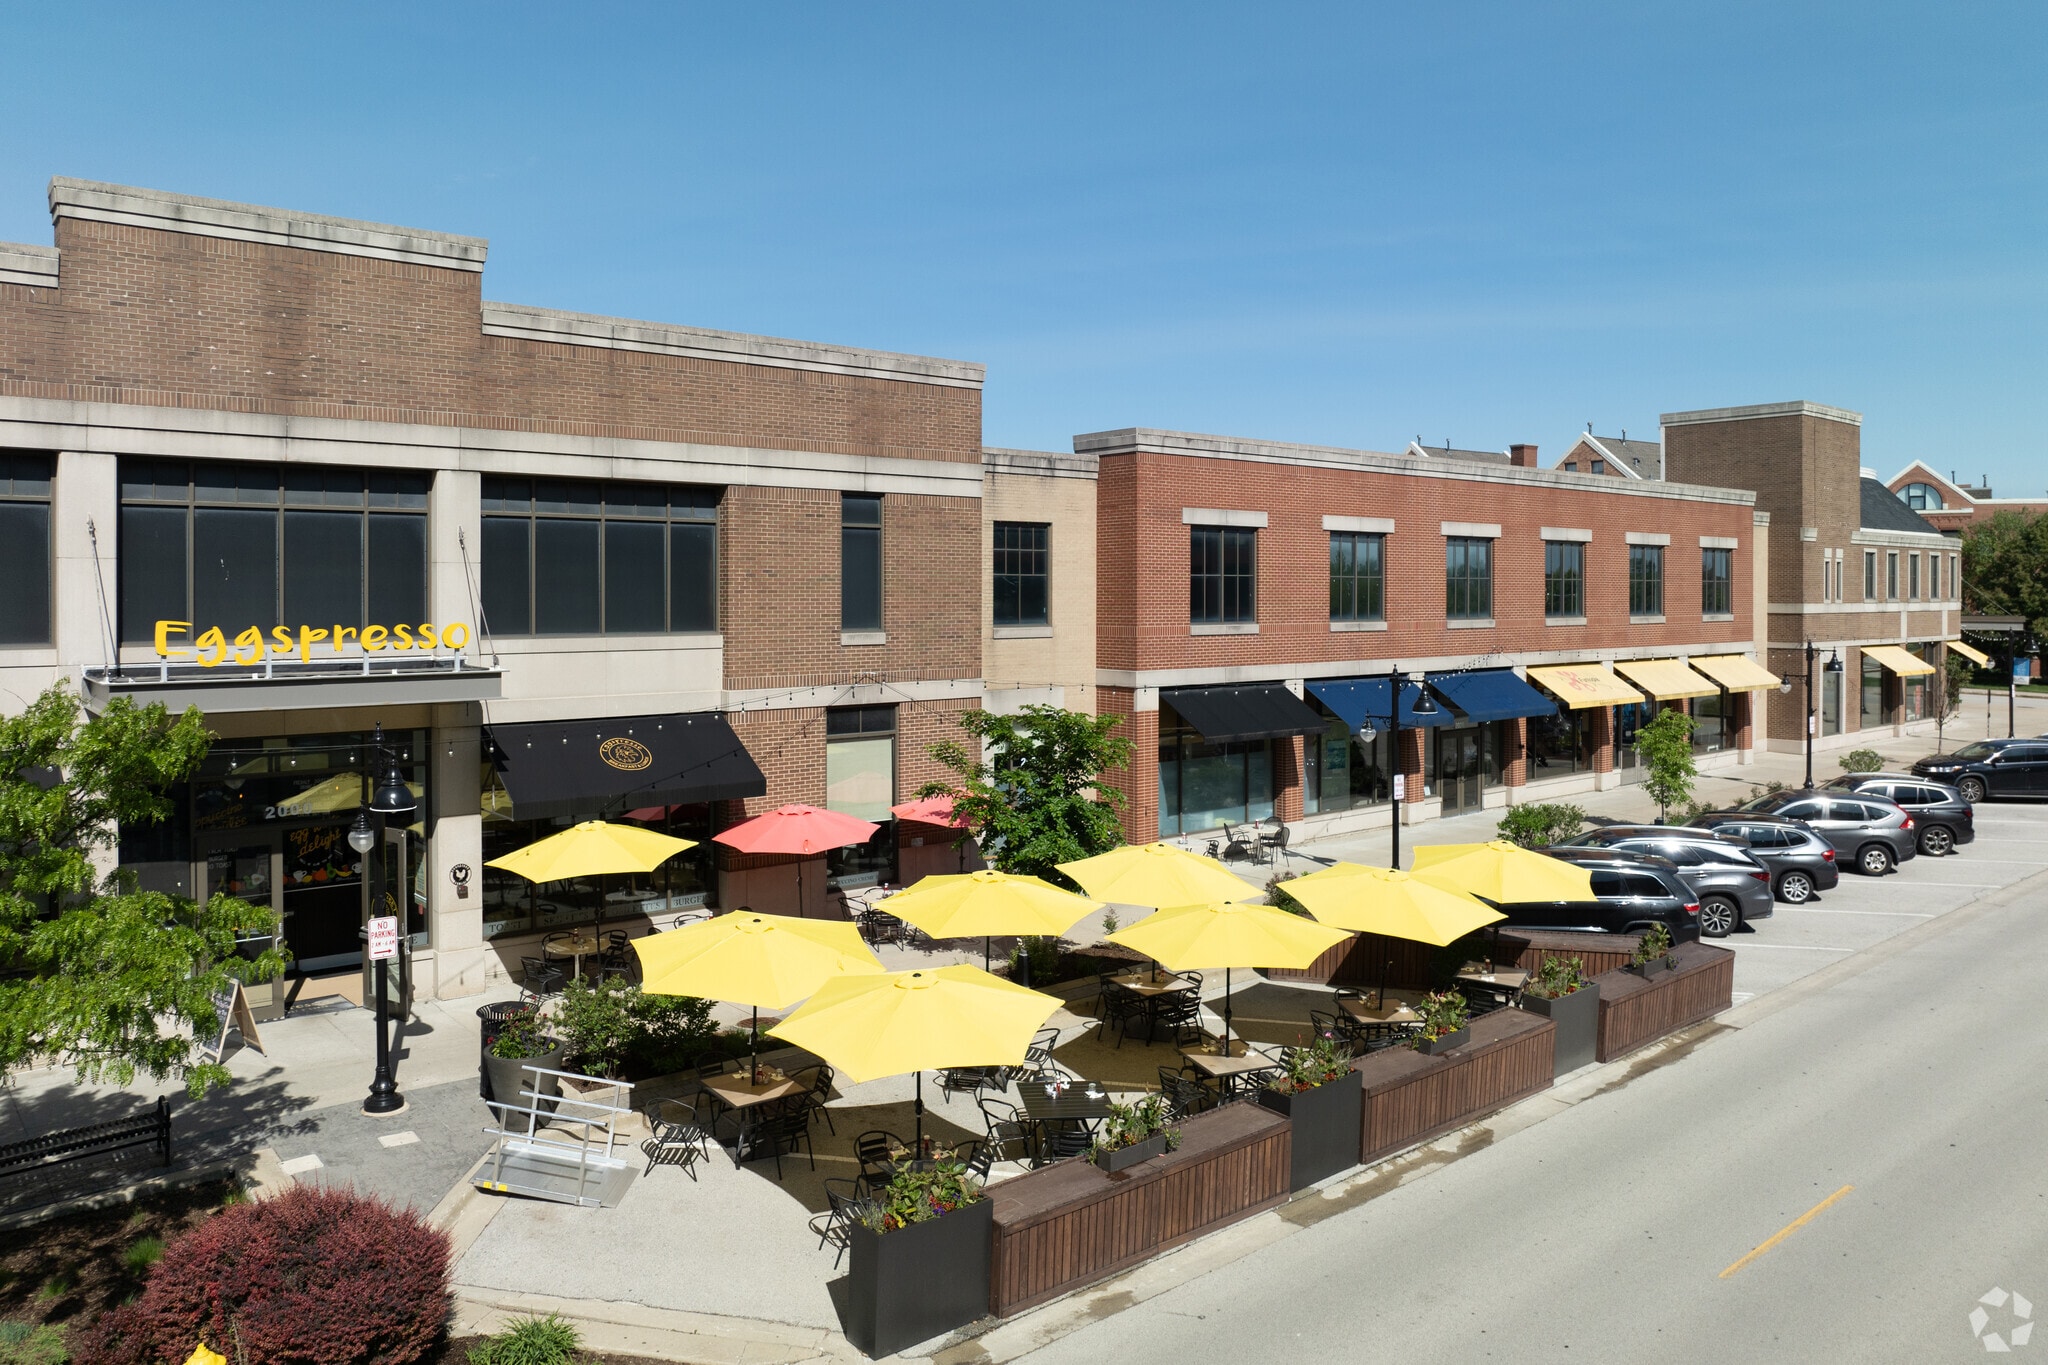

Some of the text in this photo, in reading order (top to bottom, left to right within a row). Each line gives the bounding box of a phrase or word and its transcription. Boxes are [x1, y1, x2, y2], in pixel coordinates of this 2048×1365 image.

[154, 620, 470, 668] Eggspresso
[265, 802, 313, 819] 2000
[297, 828, 341, 857] delight
[377, 921, 388, 930] NO
[488, 921, 521, 933] TOAST
[371, 929, 395, 939] PARKING
